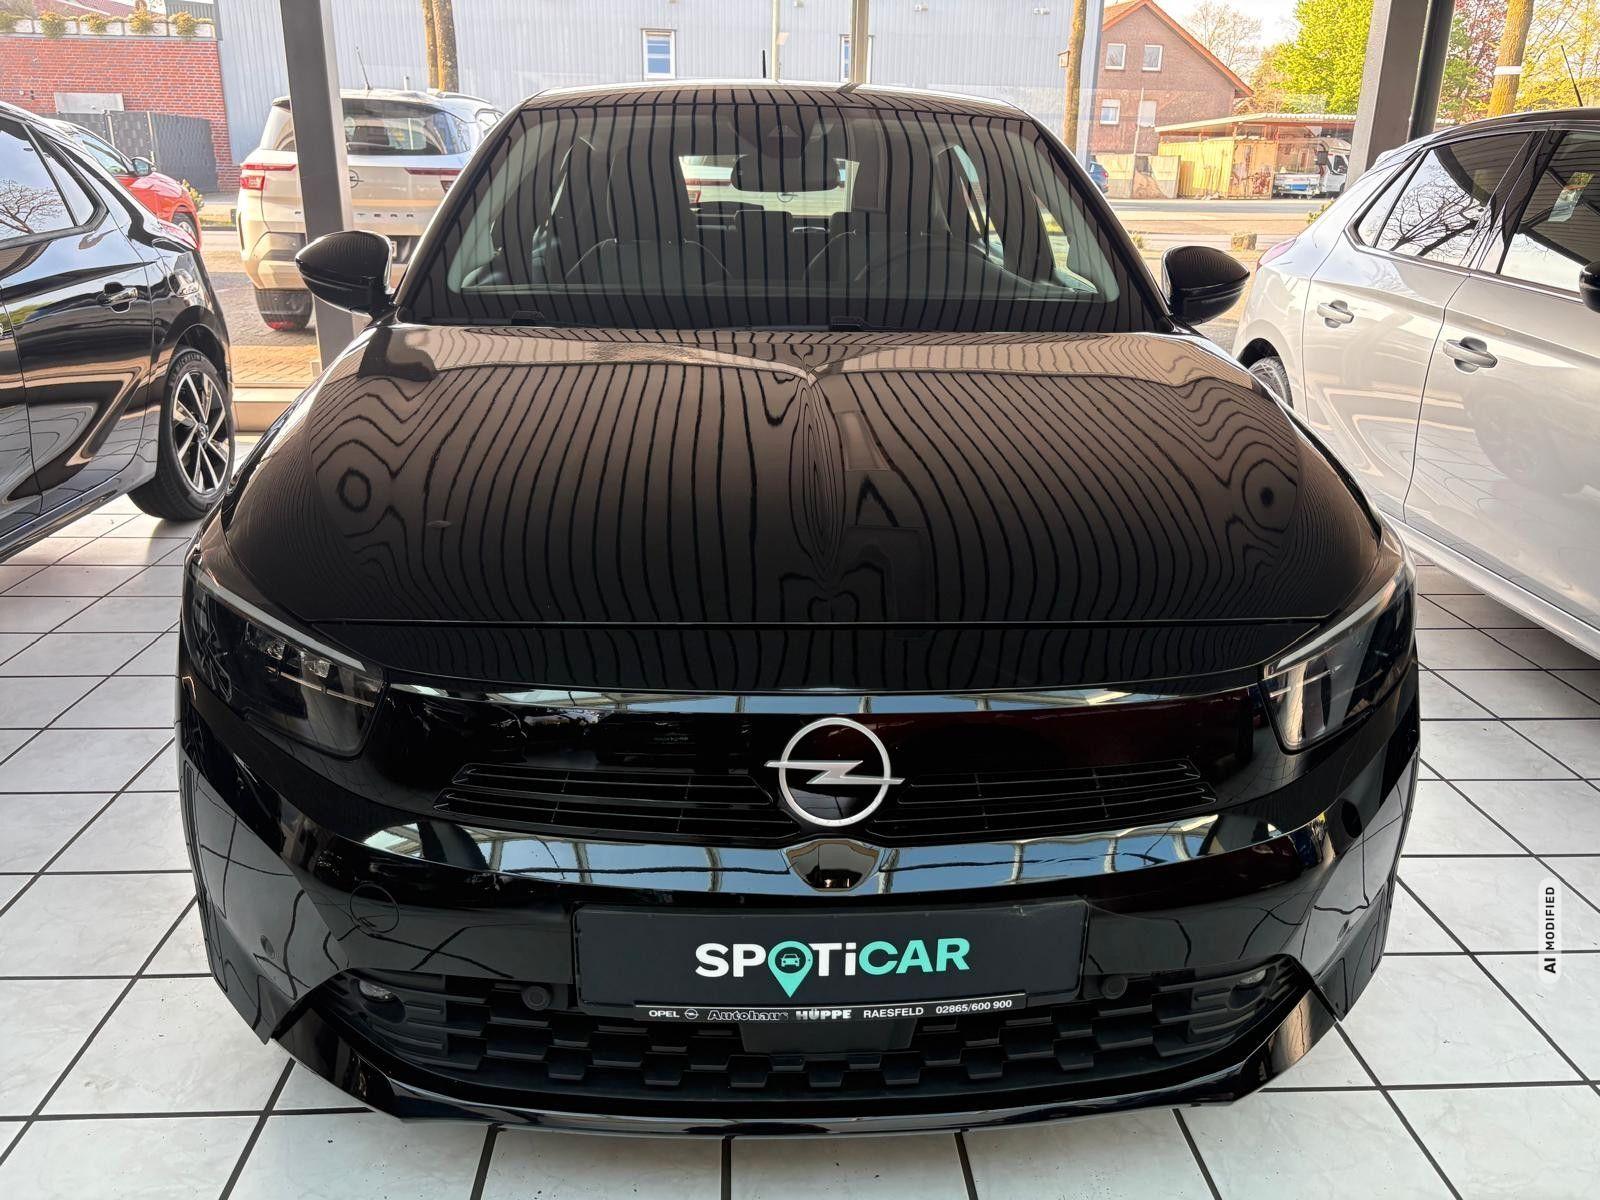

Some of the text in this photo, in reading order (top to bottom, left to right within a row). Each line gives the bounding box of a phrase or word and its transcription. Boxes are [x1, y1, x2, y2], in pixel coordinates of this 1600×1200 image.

[648, 1009, 680, 1019] OPEL
[796, 1008, 852, 1020] HÜPPE
[863, 1006, 924, 1019] RAESFELD
[935, 1002, 991, 1014] 02865/600
[993, 1000, 1013, 1010] 900
